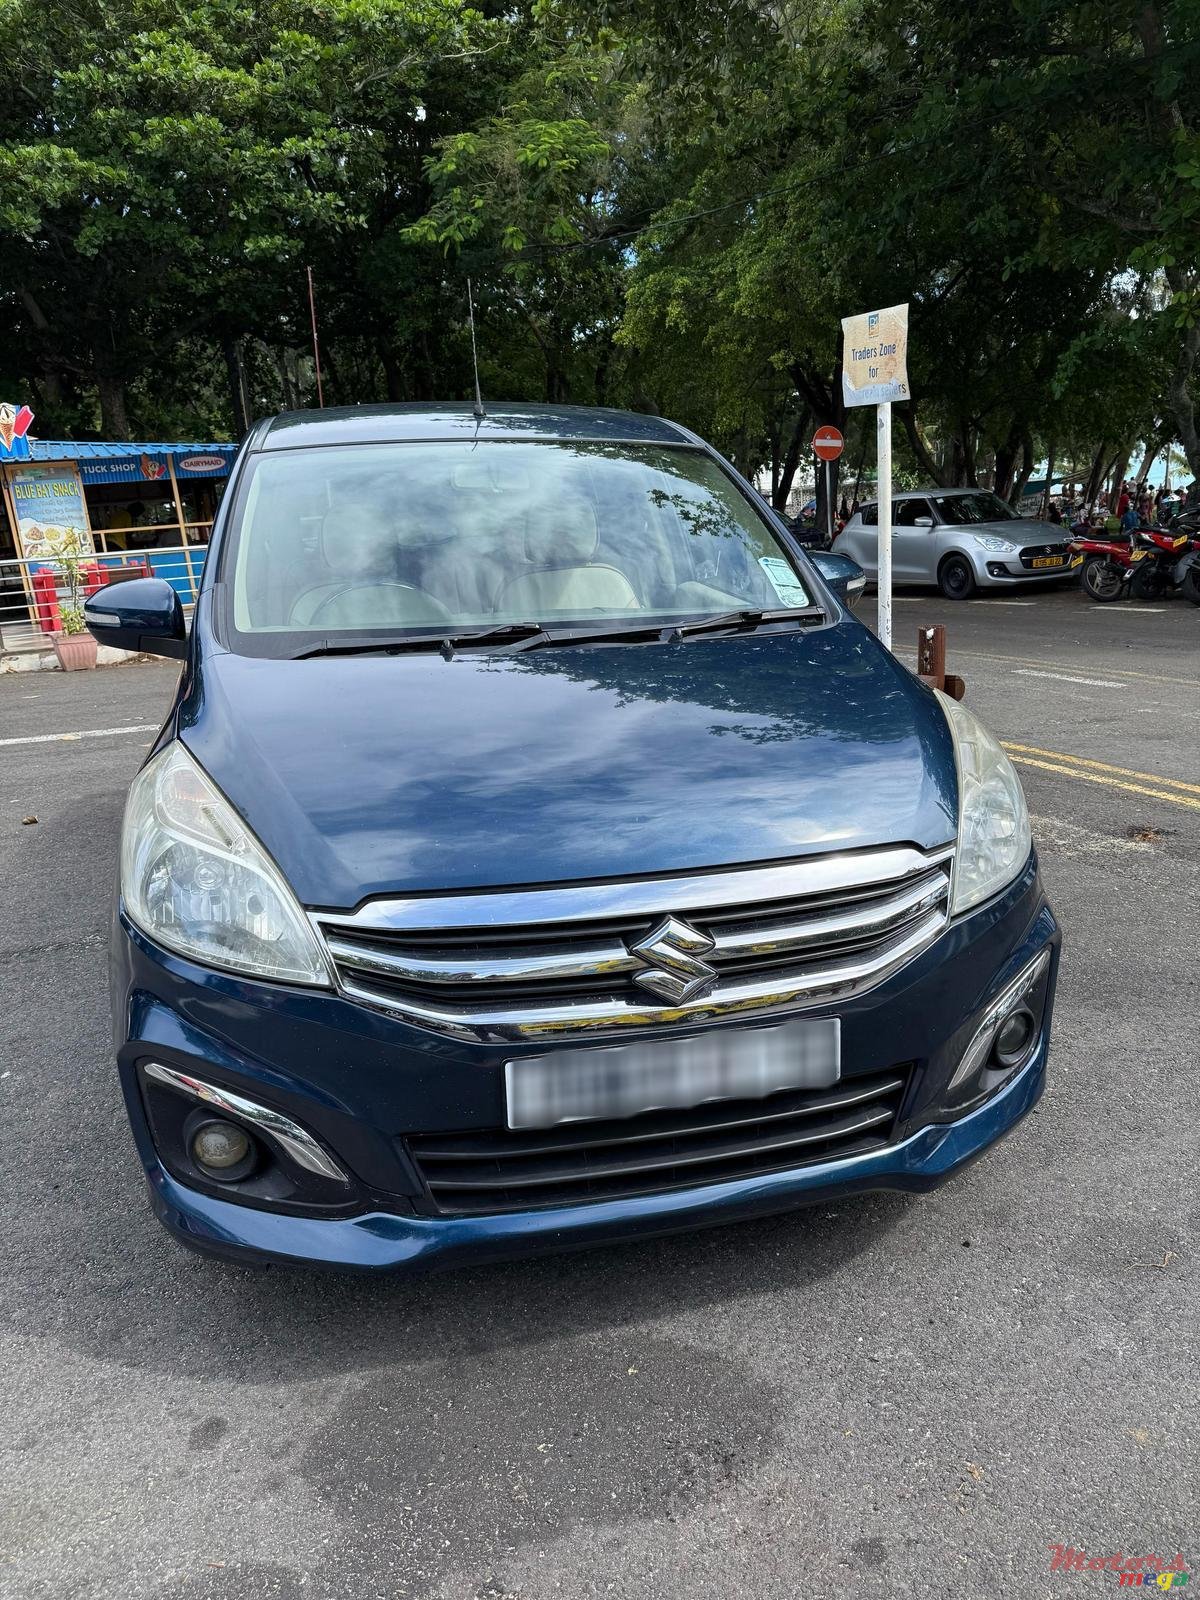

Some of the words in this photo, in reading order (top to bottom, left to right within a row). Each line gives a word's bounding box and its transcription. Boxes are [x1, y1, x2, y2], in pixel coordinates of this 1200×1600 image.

[851, 346, 878, 361] Traders
[879, 343, 897, 356] Zone
[868, 366, 879, 378] for
[82, 465, 108, 474] TUCK
[110, 463, 136, 473] SHOP
[184, 459, 222, 468] DAIRYMAID
[15, 484, 36, 499] BLUE
[35, 483, 52, 498] BAY
[52, 480, 80, 497] SNACK
